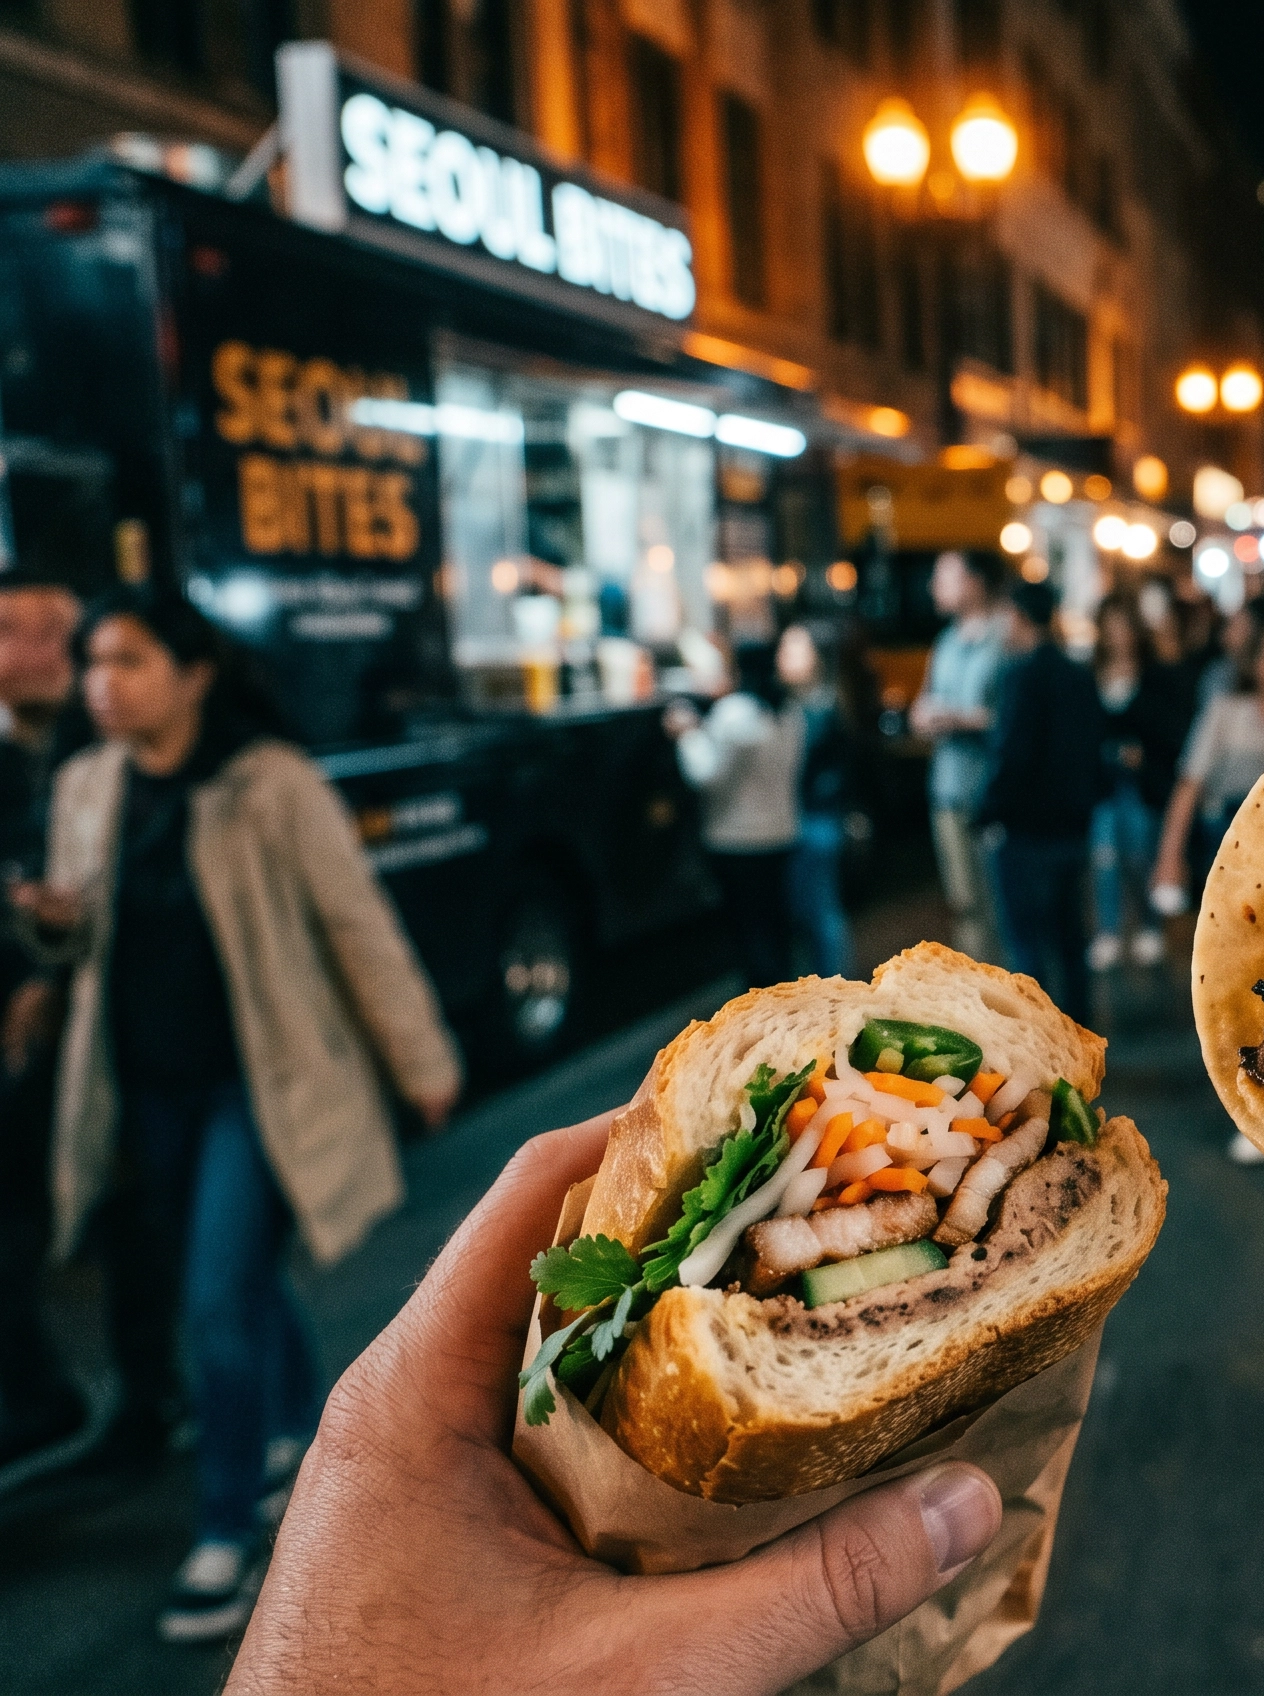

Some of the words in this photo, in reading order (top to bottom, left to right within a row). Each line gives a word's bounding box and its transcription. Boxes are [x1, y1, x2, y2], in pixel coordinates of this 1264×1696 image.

[341, 93, 557, 274] SEOUL
[552, 182, 695, 321] BITES
[238, 455, 420, 561] BITES
